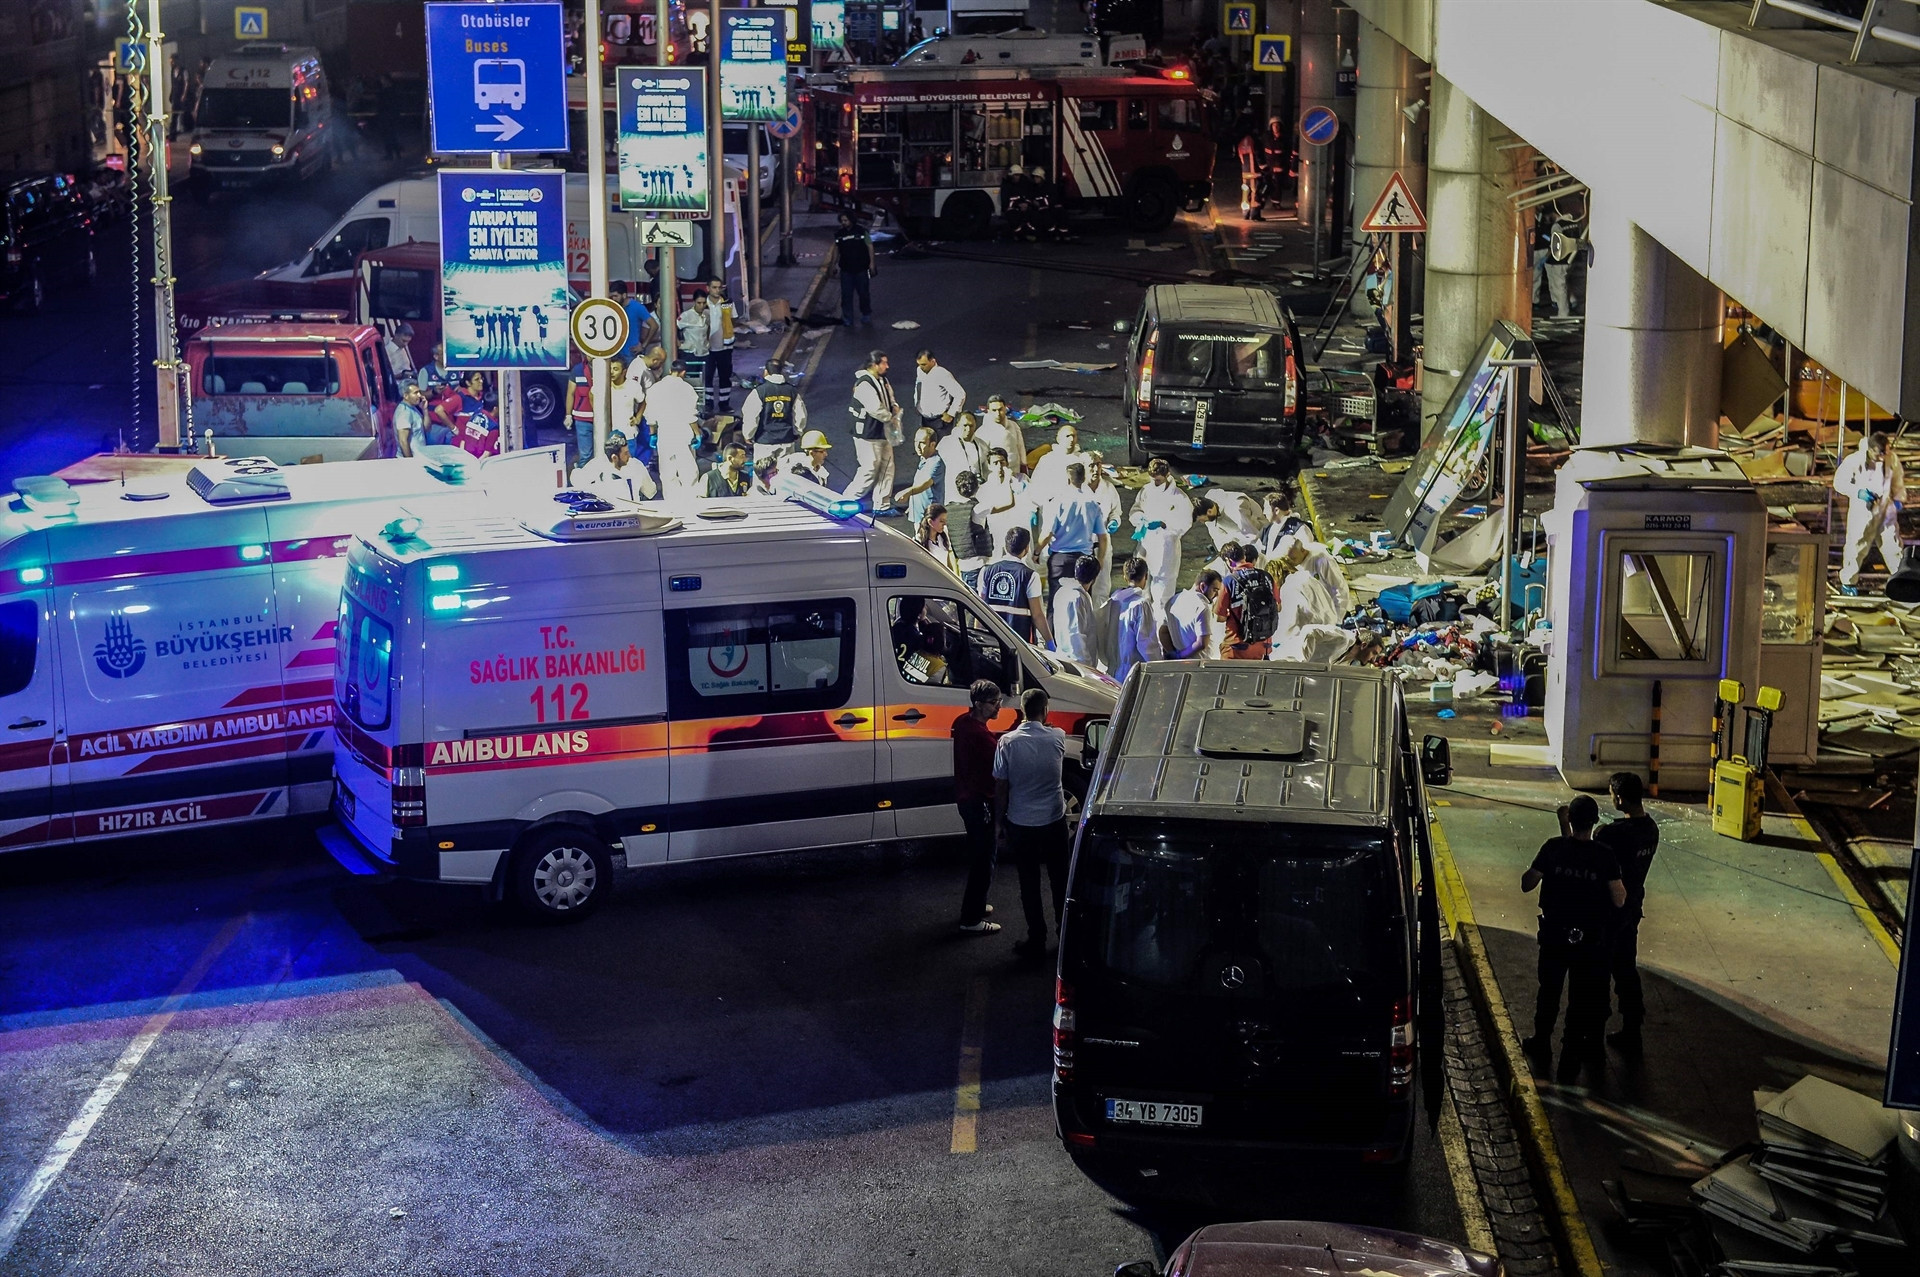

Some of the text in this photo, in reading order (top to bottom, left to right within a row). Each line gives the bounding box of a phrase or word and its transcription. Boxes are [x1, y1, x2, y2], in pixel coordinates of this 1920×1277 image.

[461, 13, 531, 28] Otobüsler
[465, 39, 508, 53] Buses
[787, 43, 807, 53] CAR
[786, 54, 801, 62] TLE
[250, 69, 270, 78] 112
[873, 92, 1031, 103] İSTANBUL BÜYÜKŞEHİR BELEDİYESİ
[469, 210, 538, 226] AVRUPA'NIN
[469, 228, 488, 247] EN
[567, 252, 590, 273] 12
[584, 314, 618, 341] 30
[1196, 402, 1206, 420] 6216
[1195, 422, 1204, 431] TP
[585, 520, 627, 529] eurostar
[178, 614, 264, 631] İSTANBUL
[155, 623, 293, 658] BÜYÜKŞEHİR
[539, 625, 575, 650] T.C.
[183, 651, 268, 670] BELEDİYESİ
[470, 644, 645, 684] SAĞLIK BAKANLIĞI
[530, 682, 590, 723] 112
[79, 705, 333, 757] ACİL YARDIM AMBULANSI
[431, 730, 590, 765] AMBULANS
[99, 802, 207, 832] HIZIR ACİL
[1554, 866, 1598, 881] POLİS
[1116, 1102, 1198, 1123] 34 YB 7305
